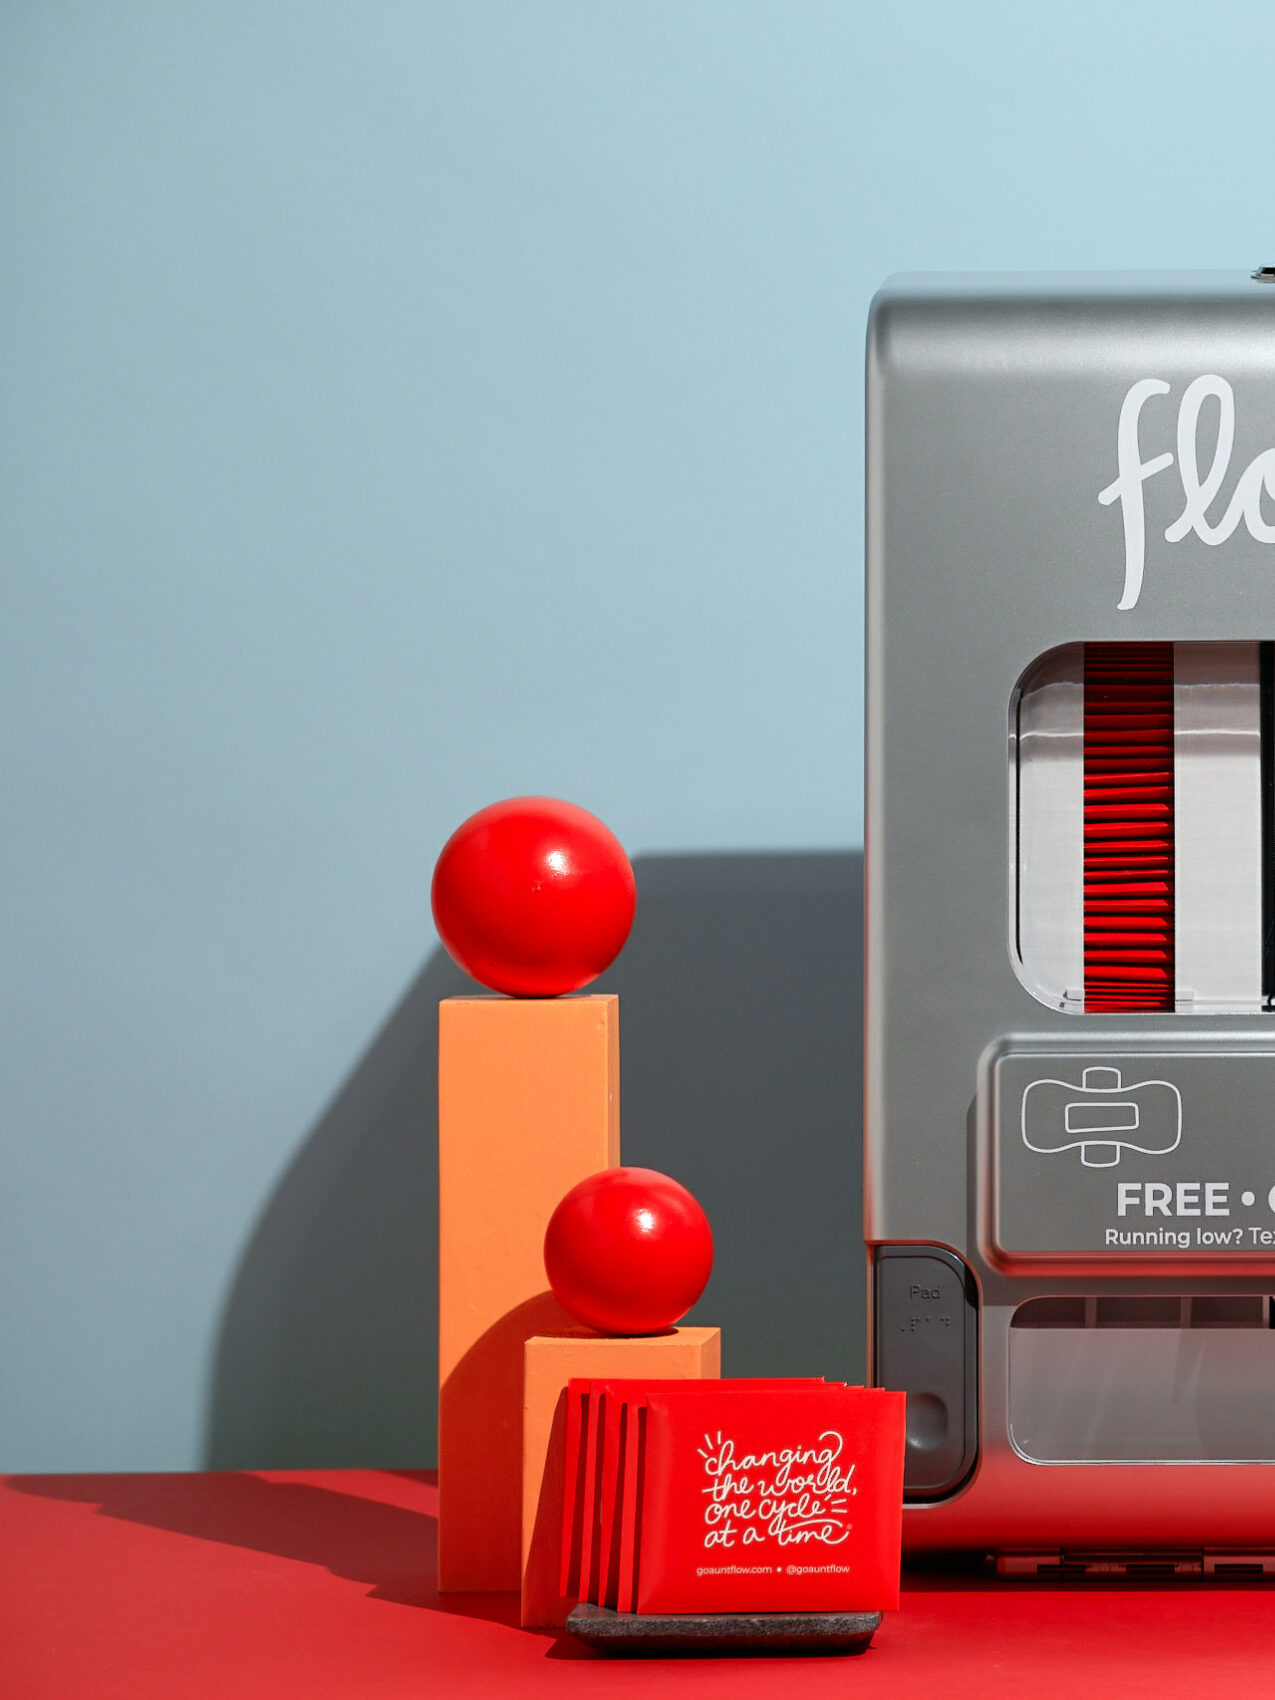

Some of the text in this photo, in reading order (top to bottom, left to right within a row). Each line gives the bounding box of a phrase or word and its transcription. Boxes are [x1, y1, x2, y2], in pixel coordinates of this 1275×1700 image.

[1117, 1182, 1230, 1216] FREE
[1105, 1227, 1191, 1249] Running
[1196, 1227, 1243, 1245] low?
[910, 1284, 941, 1300] Pad
[705, 1431, 844, 1486] changing
[702, 1464, 857, 1502] the world,
[705, 1493, 825, 1536] one cycle
[704, 1518, 849, 1548] at a time
[696, 1564, 850, 1577] goauntflow.com @goauntflow
